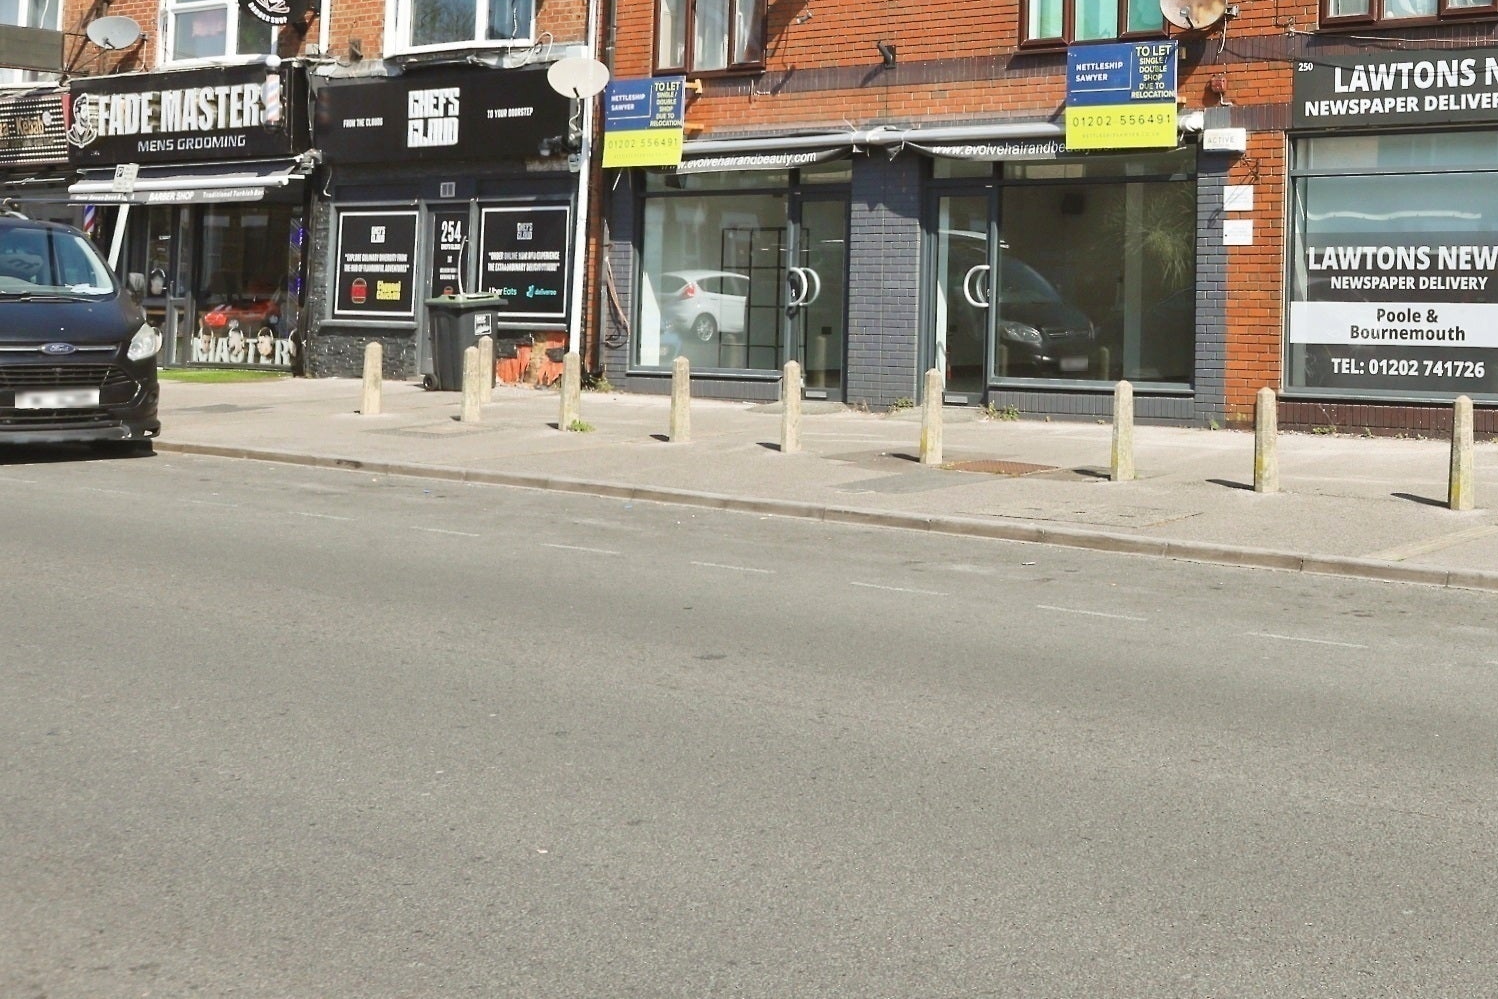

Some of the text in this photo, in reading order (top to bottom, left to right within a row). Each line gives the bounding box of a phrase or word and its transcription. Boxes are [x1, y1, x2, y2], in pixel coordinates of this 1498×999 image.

[1136, 44, 1172, 57] TO LET
[1076, 61, 1123, 71] NETTLESHIP
[1139, 56, 1163, 65] SINGLE
[1139, 65, 1167, 73] DOUBLE
[1298, 62, 1313, 72] 250
[1076, 73, 1108, 82] SAWYER
[1143, 73, 1163, 82] SHOP
[1334, 58, 1476, 93] LAWTONS
[654, 81, 680, 91] TO LET
[1139, 82, 1153, 90] DUE
[611, 93, 646, 102] NETTLESHIP
[1131, 90, 1175, 99] RELOCATION
[611, 103, 635, 111] SAWYER
[1304, 96, 1419, 117] NEWSPAPER
[98, 92, 153, 136] FADE
[1073, 114, 1170, 128] 01202 556491
[138, 135, 246, 152] MENS GROOMING
[149, 190, 194, 201] BARBER SHOP
[441, 220, 461, 243] 254
[1308, 246, 1430, 271] LAWTONS
[1330, 276, 1488, 290] NEWSPAPER DELIVERY
[503, 287, 517, 295] Eats
[1376, 308, 1438, 324] Poole &
[1350, 325, 1466, 341] Bournemouth
[1331, 358, 1485, 378] TEL: 01202 741726
